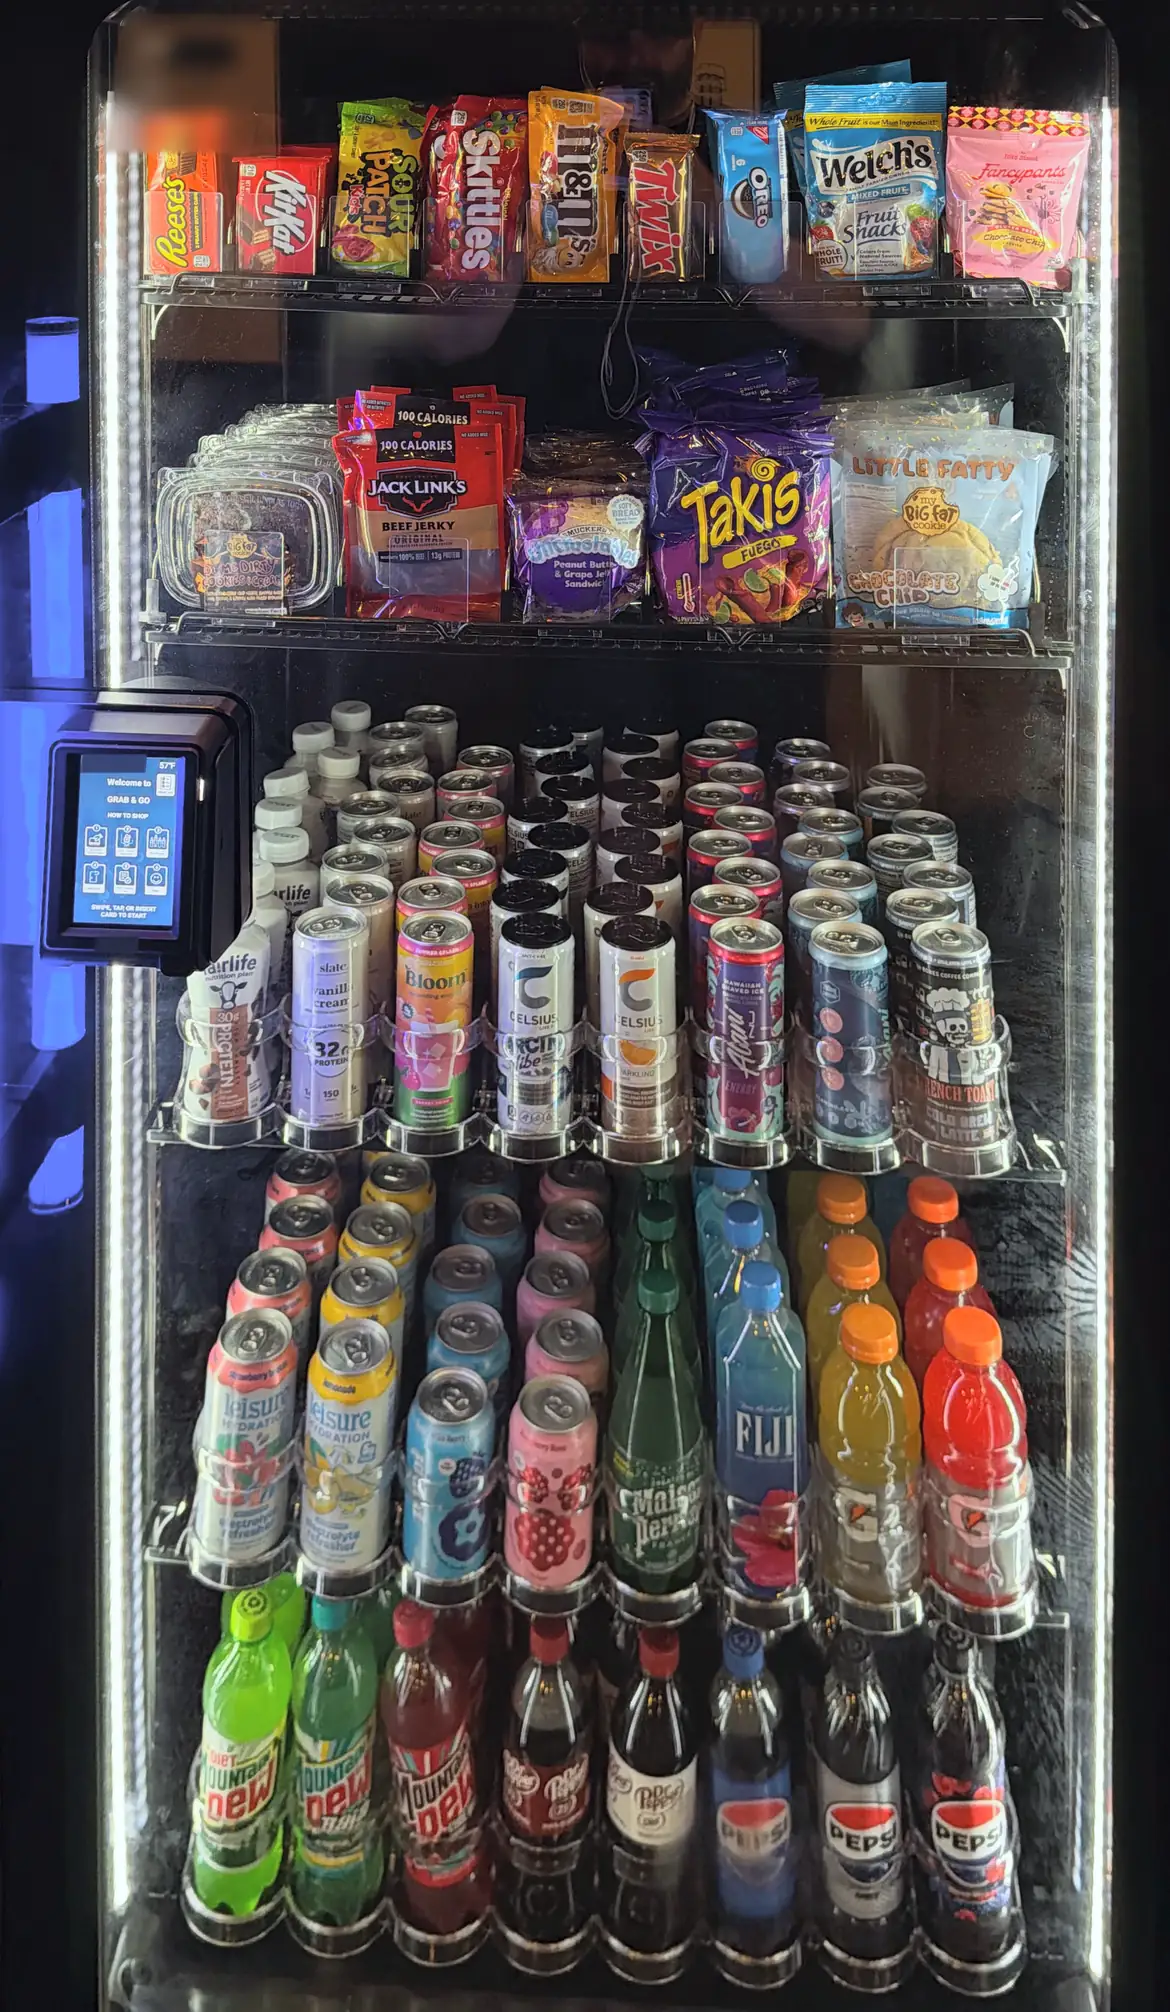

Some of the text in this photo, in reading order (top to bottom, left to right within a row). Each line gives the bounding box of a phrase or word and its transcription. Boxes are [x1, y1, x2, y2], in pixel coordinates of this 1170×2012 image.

[809, 115, 837, 125] Whole
[838, 115, 861, 126] Fruit
[815, 139, 933, 188] Welch's
[972, 163, 1066, 184] Fancypants
[349, 184, 364, 215] Kids
[362, 152, 391, 236] PATCH
[389, 153, 417, 233] SOUR
[462, 129, 500, 270] Skittles
[749, 166, 773, 229] OREO
[851, 186, 907, 200] MIXED FRUIT
[155, 176, 188, 268] Reese's
[857, 204, 900, 227] Fruit
[843, 221, 907, 243] Snacks
[397, 410, 468, 425] 100 CALORIES
[380, 440, 453, 451] 100 CALORIES
[937, 458, 1015, 481] FATTY
[367, 479, 467, 496] JACK LINK'S
[919, 496, 937, 506] my
[612, 508, 640, 517] BREAD
[382, 520, 455, 532] BEEF JERKY
[913, 519, 946, 531] cookie
[394, 534, 444, 544] ORIGINAL
[740, 540, 780, 562] FUEGO
[554, 561, 587, 569] Peanut
[564, 570, 594, 579] Grape
[847, 568, 960, 594] CHOCOLATE
[565, 579, 604, 588] Sandwic
[107, 777, 151, 788] Welcome to
[107, 795, 151, 805] GRAB & GO
[107, 811, 121, 819] HOW
[569, 808, 594, 818] ELSIUS
[507, 827, 529, 840] ELSIUS
[319, 962, 348, 973] slate
[404, 967, 466, 990] Bloom
[751, 986, 765, 994] ICE
[216, 1010, 240, 1024] 30g
[509, 1010, 558, 1026] CELSIUS
[725, 1002, 760, 1079] Alani
[217, 1022, 235, 1088] PROTEIN
[314, 1055, 349, 1067] PROTEIN
[621, 1069, 655, 1078] ARKLING
[322, 1088, 340, 1098] 150
[923, 1077, 997, 1103] RENCH TOAST
[309, 1399, 371, 1432] leisure
[308, 1420, 370, 1444] YDRATION
[736, 1410, 793, 1457] FIJI
[830, 1822, 896, 1852] PEPSI
[935, 1821, 1001, 1852] PEPSI
